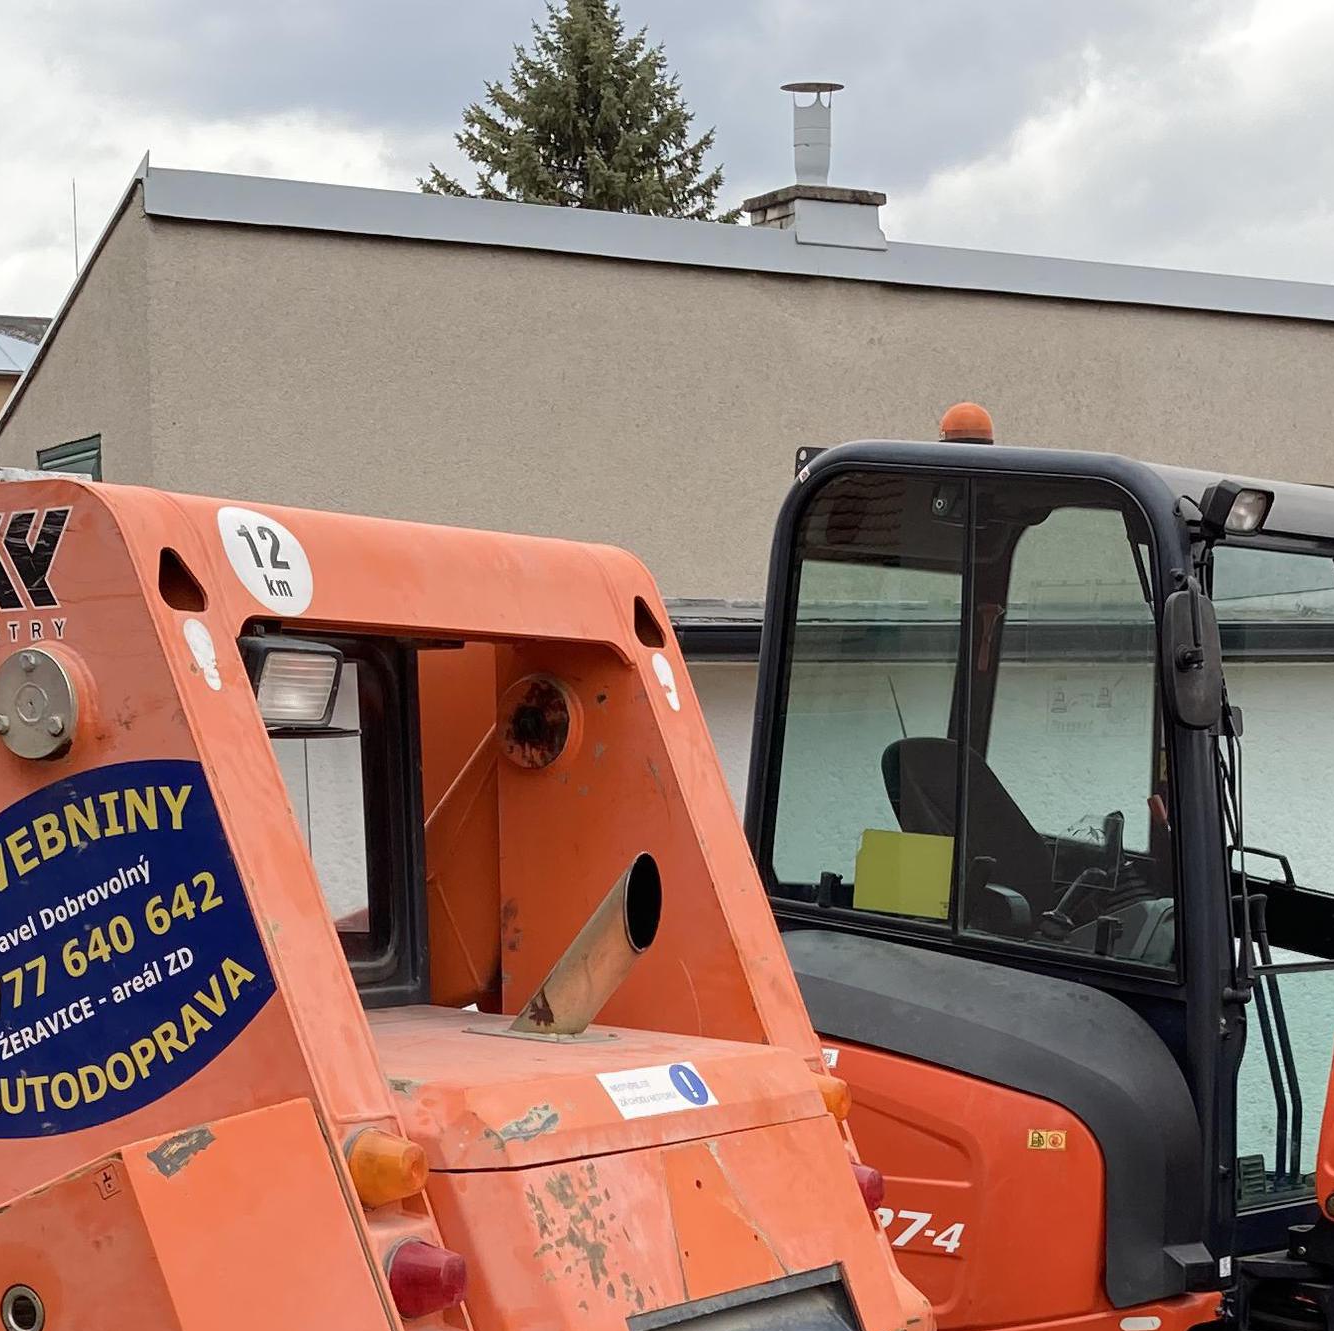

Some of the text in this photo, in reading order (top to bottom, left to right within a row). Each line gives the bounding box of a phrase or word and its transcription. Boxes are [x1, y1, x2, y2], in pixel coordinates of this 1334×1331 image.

[236, 524, 290, 569] 12
[263, 573, 293, 597] km
[39, 855, 151, 922] Dobrovolný
[62, 915, 135, 978] 640
[144, 871, 223, 936] 642
[111, 960, 163, 1004] areál
[163, 947, 195, 977] ZD
